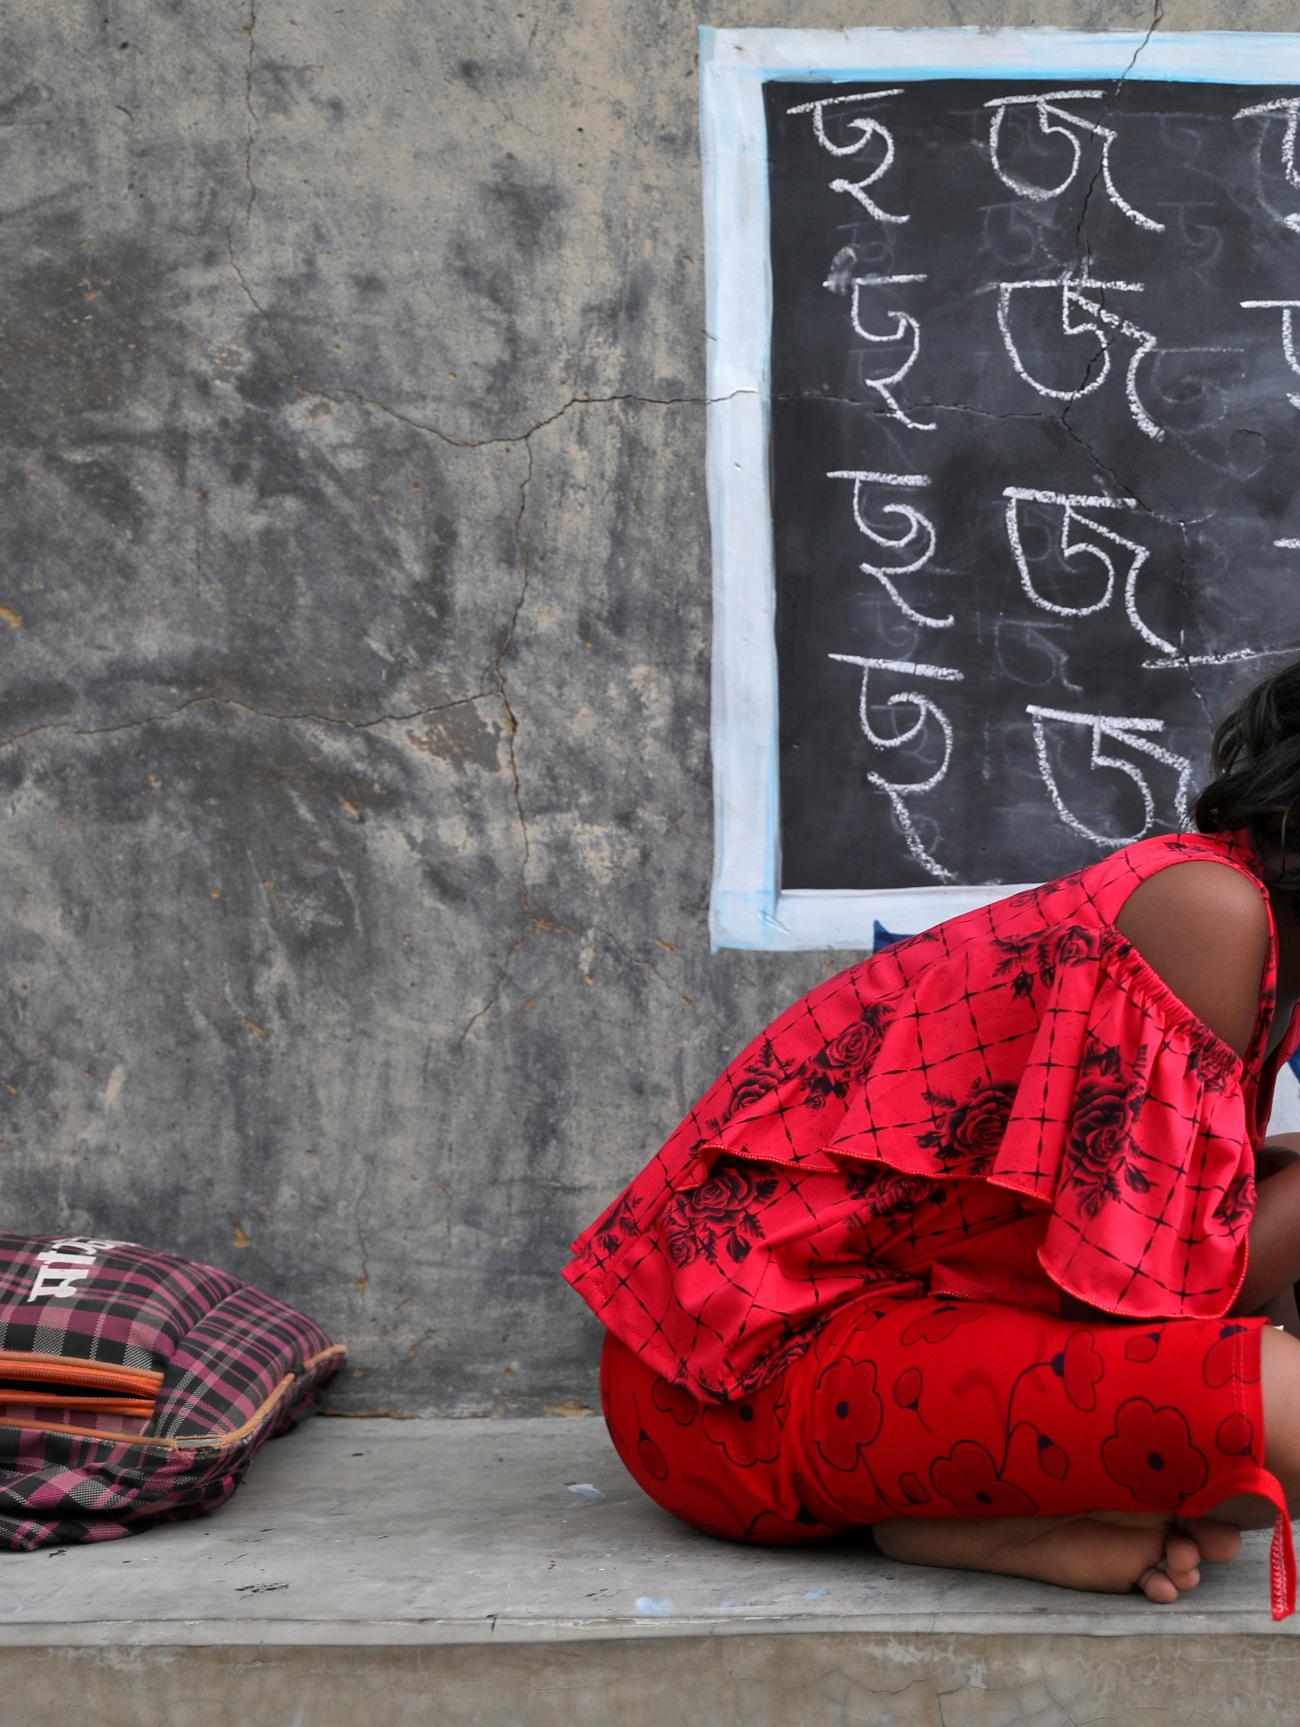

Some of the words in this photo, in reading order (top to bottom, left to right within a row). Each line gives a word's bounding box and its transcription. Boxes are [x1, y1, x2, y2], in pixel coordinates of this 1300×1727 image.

[983, 89, 1166, 233] জ
[996, 278, 1166, 441] জ
[1002, 485, 1184, 658] জ
